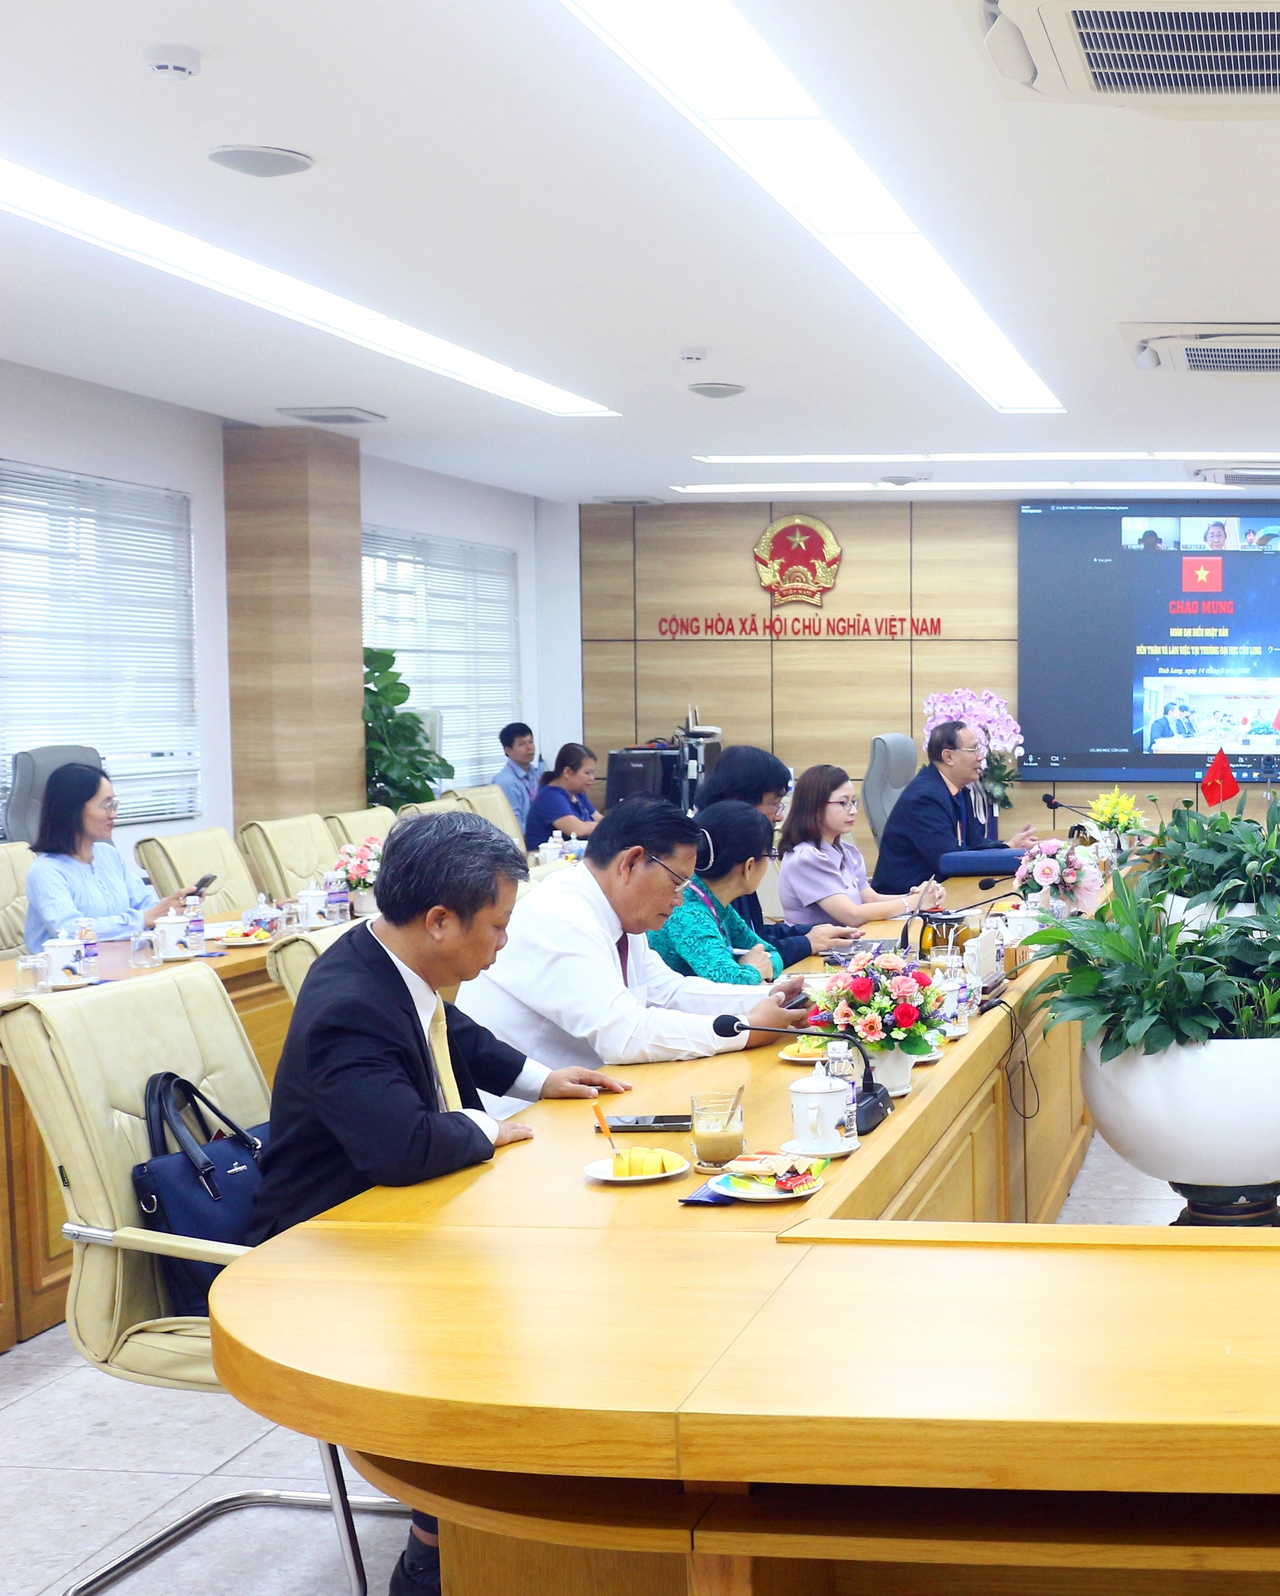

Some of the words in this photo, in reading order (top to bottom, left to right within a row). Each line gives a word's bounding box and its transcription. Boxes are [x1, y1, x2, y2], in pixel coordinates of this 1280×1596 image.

[658, 614, 700, 640] CỘNG
[704, 612, 735, 636] HÒA
[738, 613, 759, 636] XÃ
[763, 614, 788, 640] HỘI
[791, 612, 822, 636] CHỦ
[826, 613, 871, 636] NGHĨA
[874, 615, 907, 640] VIỆT
[910, 617, 942, 636] NAM
